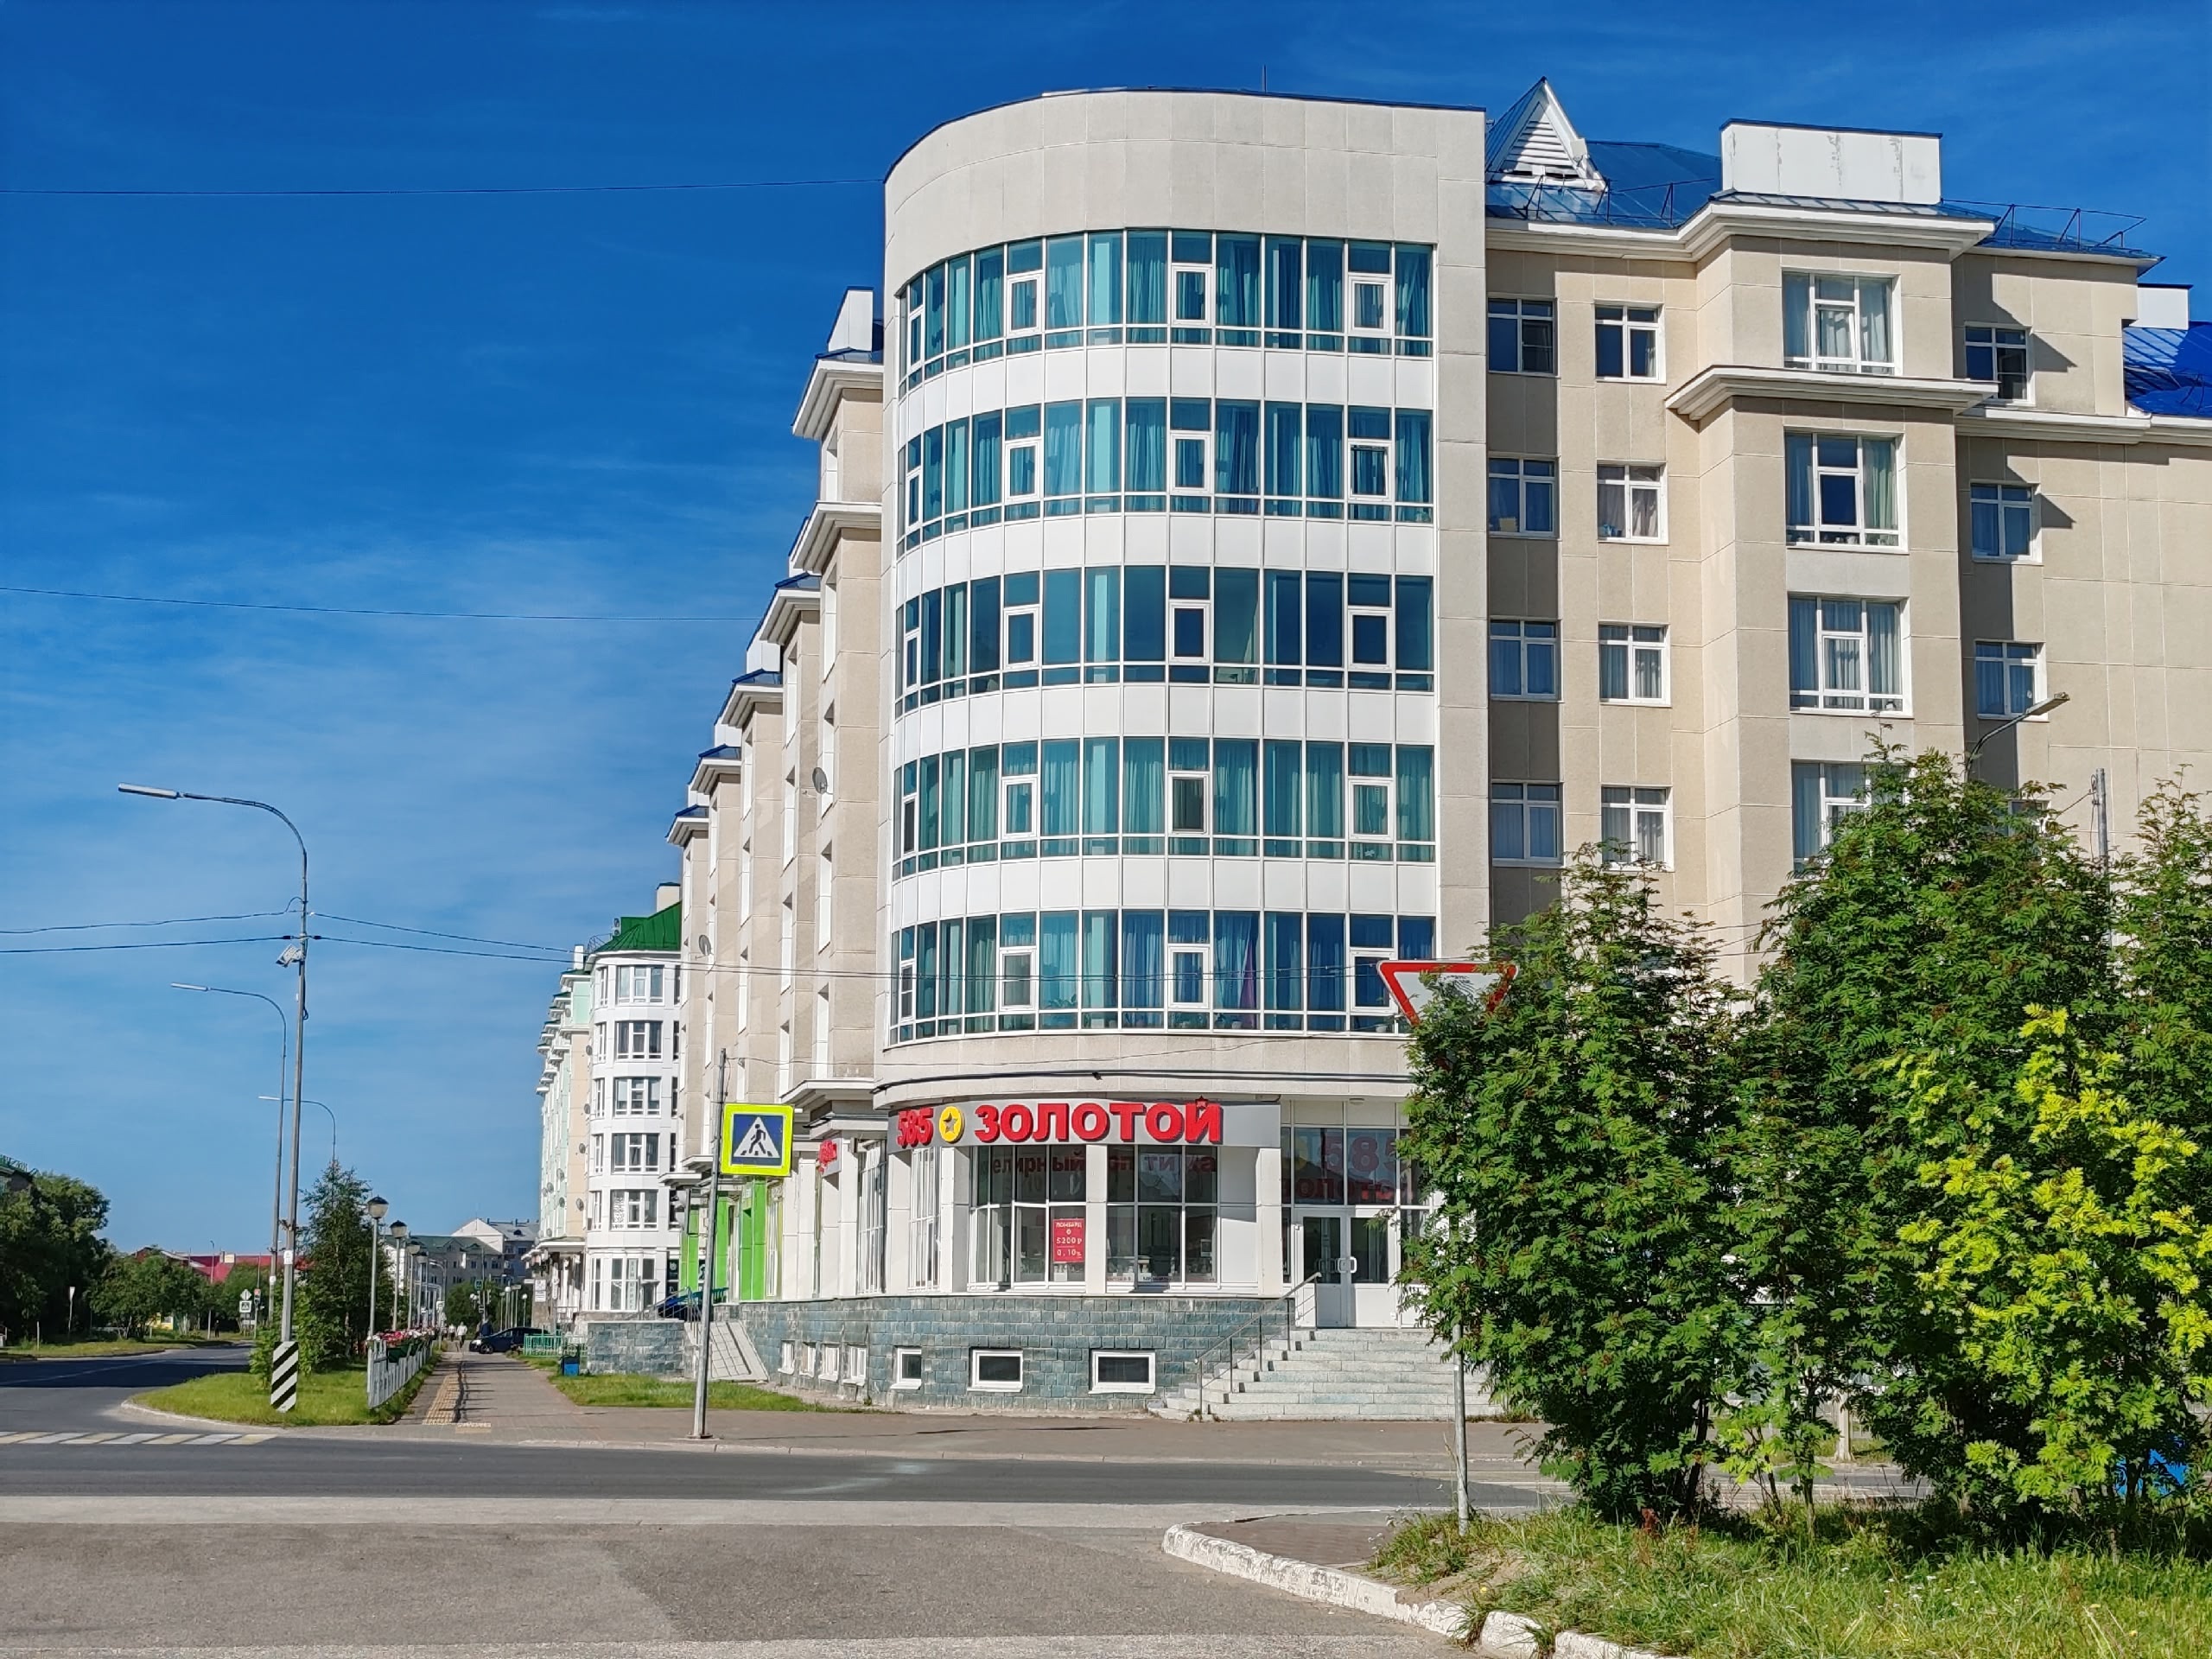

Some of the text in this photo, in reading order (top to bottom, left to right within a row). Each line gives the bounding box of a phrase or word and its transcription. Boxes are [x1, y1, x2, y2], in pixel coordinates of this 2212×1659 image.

[897, 1096, 1223, 1149] 585 ЗОЛОТОЙ
[982, 1151, 1086, 1177] елирный
